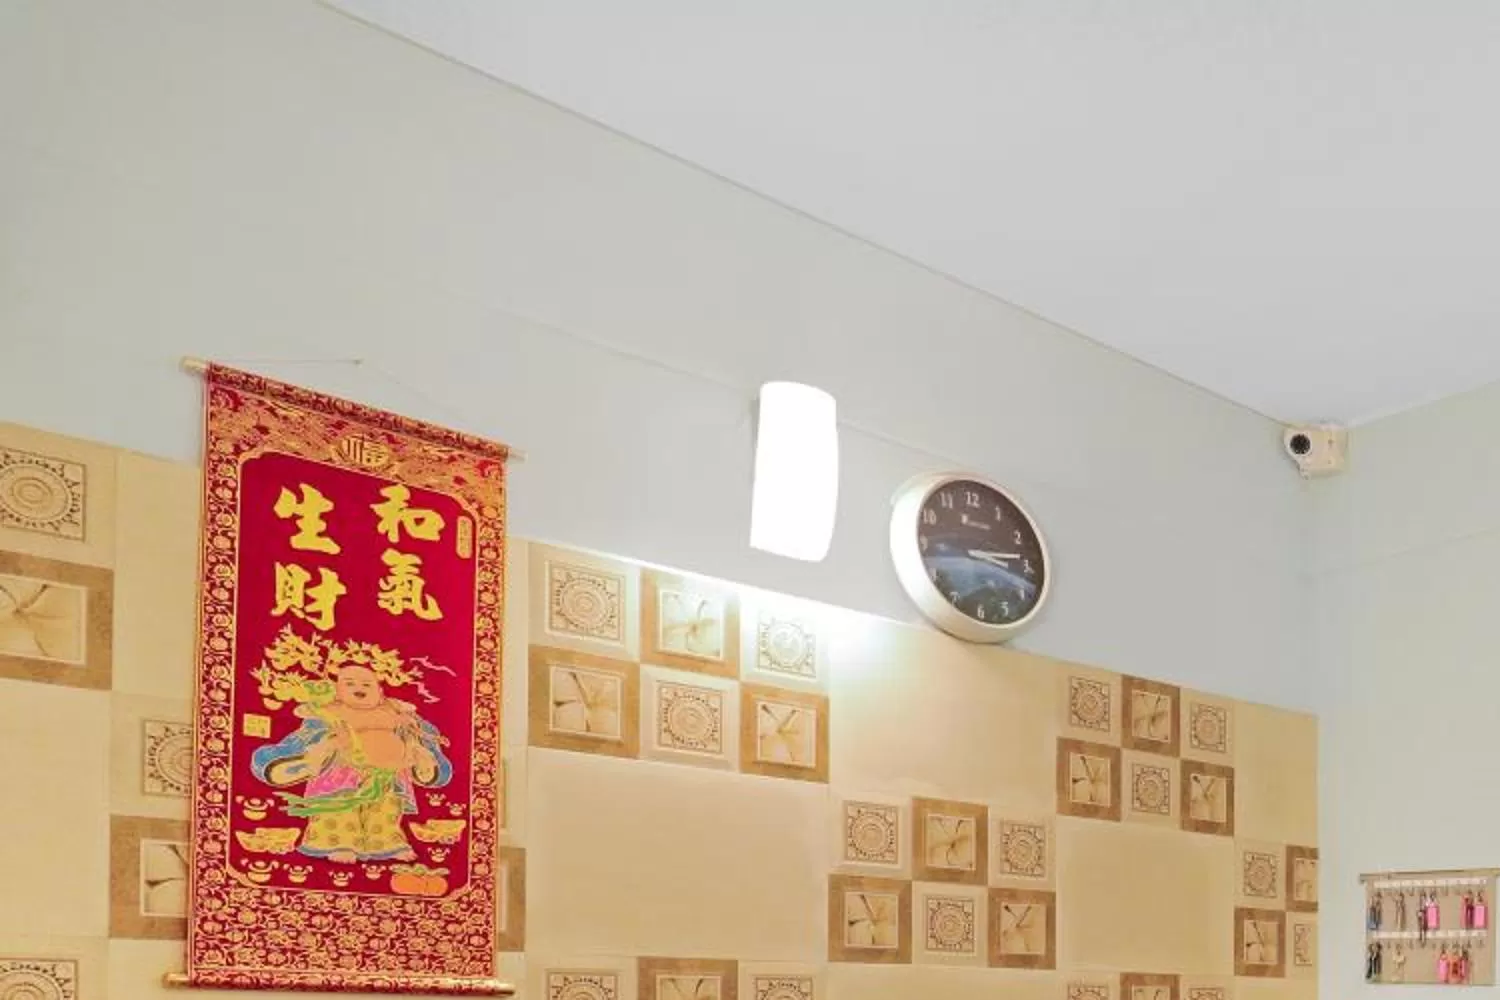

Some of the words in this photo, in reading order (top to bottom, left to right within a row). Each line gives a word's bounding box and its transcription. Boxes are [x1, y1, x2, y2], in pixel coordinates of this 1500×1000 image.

[940, 491, 954, 509] 11
[965, 491, 980, 508] 12
[1014, 530, 1021, 545] 2
